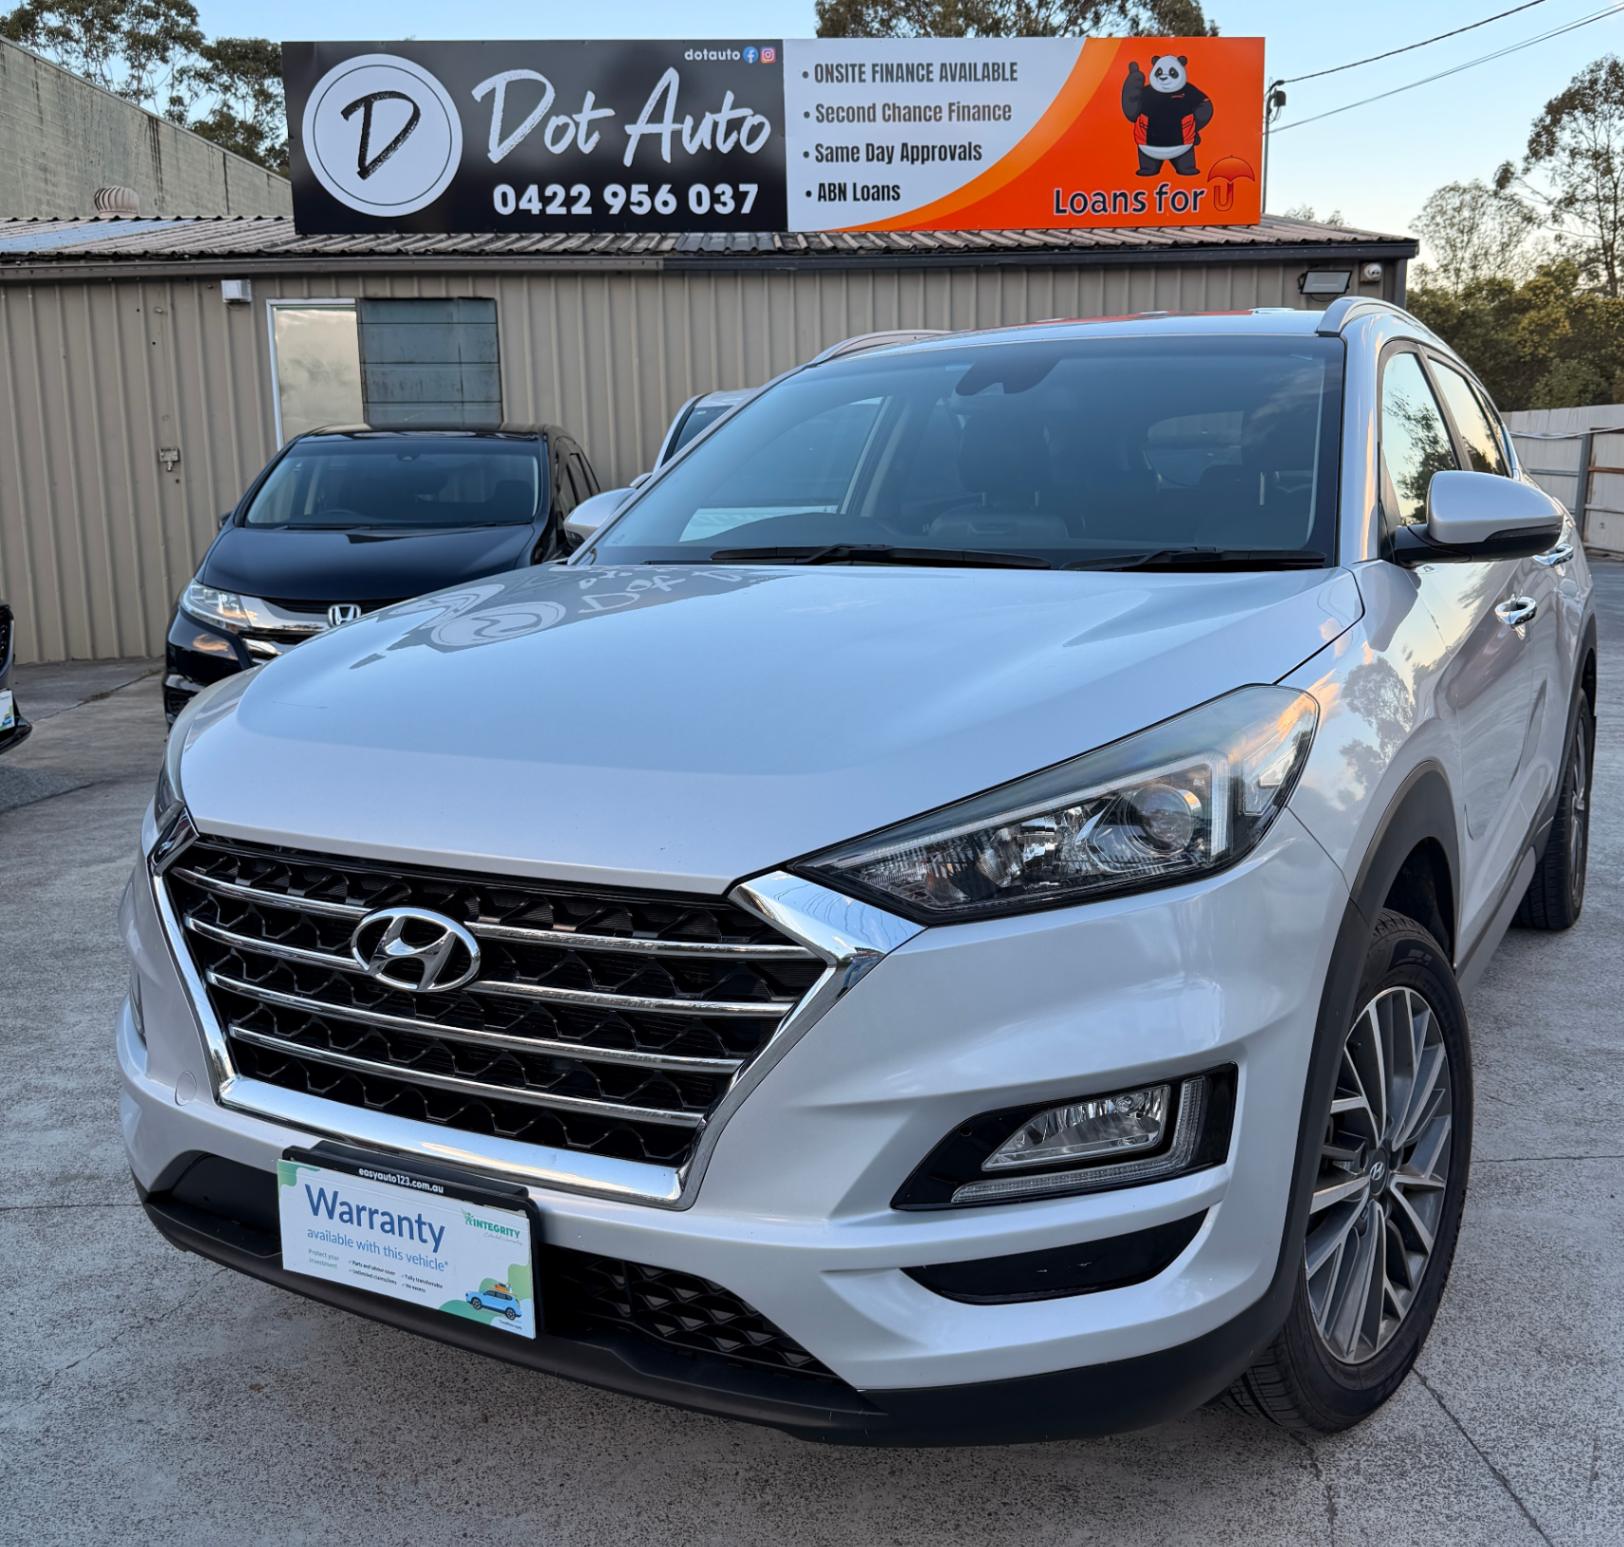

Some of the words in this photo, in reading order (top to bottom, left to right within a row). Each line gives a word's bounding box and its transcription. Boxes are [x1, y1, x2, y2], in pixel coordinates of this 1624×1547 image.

[684, 47, 741, 61] dotauto
[814, 63, 866, 84] ONSITE
[871, 62, 934, 83] FINANCE
[939, 62, 1018, 82] AVAILABLE
[471, 68, 615, 164] Dot
[624, 66, 772, 167] Auto
[815, 104, 877, 124] Second
[882, 102, 943, 123] Chance
[948, 101, 1012, 122] Finance
[340, 91, 421, 180] D
[815, 143, 861, 164] Same
[865, 142, 895, 165] Day
[899, 141, 983, 164] Approvals
[492, 184, 593, 216] 0422
[603, 184, 677, 215] 956
[687, 184, 759, 215] 037
[817, 182, 848, 202] ABN
[852, 181, 901, 202] Loans
[1053, 187, 1147, 216] Loans
[1155, 183, 1207, 213] for
[1213, 183, 1233, 212] U
[358, 1166, 445, 1194] easyauto123.com.au
[304, 1183, 446, 1253] Warranty
[473, 1218, 520, 1239] INTEGRITY
[307, 1228, 354, 1248] available
[356, 1239, 380, 1255] with
[383, 1245, 403, 1261] this
